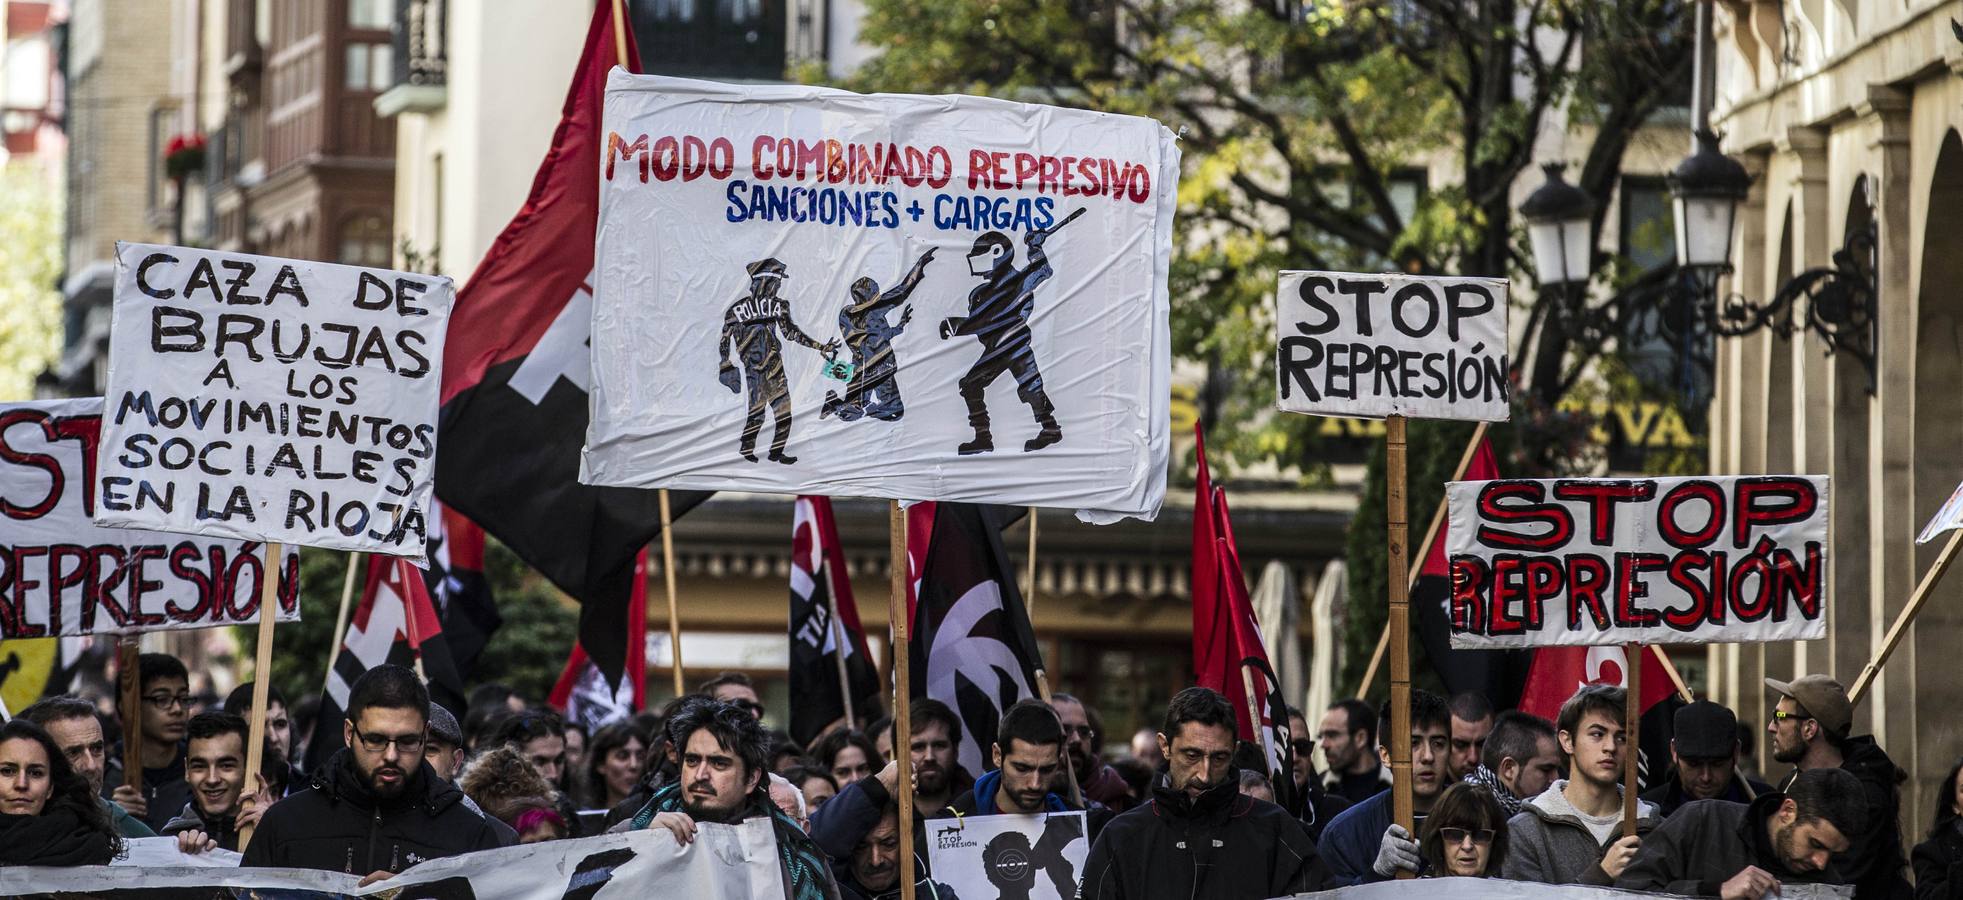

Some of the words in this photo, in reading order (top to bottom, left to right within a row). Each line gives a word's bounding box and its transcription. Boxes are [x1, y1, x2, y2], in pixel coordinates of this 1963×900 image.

[605, 132, 734, 183] MODO
[752, 135, 952, 190] COMBINADO
[967, 149, 1151, 204] REPRESIVO
[726, 180, 900, 229] SANCIONES
[905, 201, 925, 222] +
[933, 193, 1055, 232] CARGAS
[135, 252, 309, 308] CAZA
[352, 271, 429, 316] DE
[733, 298, 781, 322] POLICIA
[1296, 276, 1494, 341] STOP
[151, 306, 431, 378] BRUJAS
[1277, 336, 1509, 403] REPRESIÓN
[203, 359, 234, 388] A
[286, 368, 358, 404] LOS
[115, 390, 434, 459] MOVIMIENTOS
[118, 433, 416, 496] SOCIALES
[101, 476, 175, 514] EN
[195, 482, 256, 522] LA
[284, 489, 426, 545] RIOJA
[1476, 476, 1818, 553] STOP
[1450, 534, 1823, 636] REPRESIÓN
